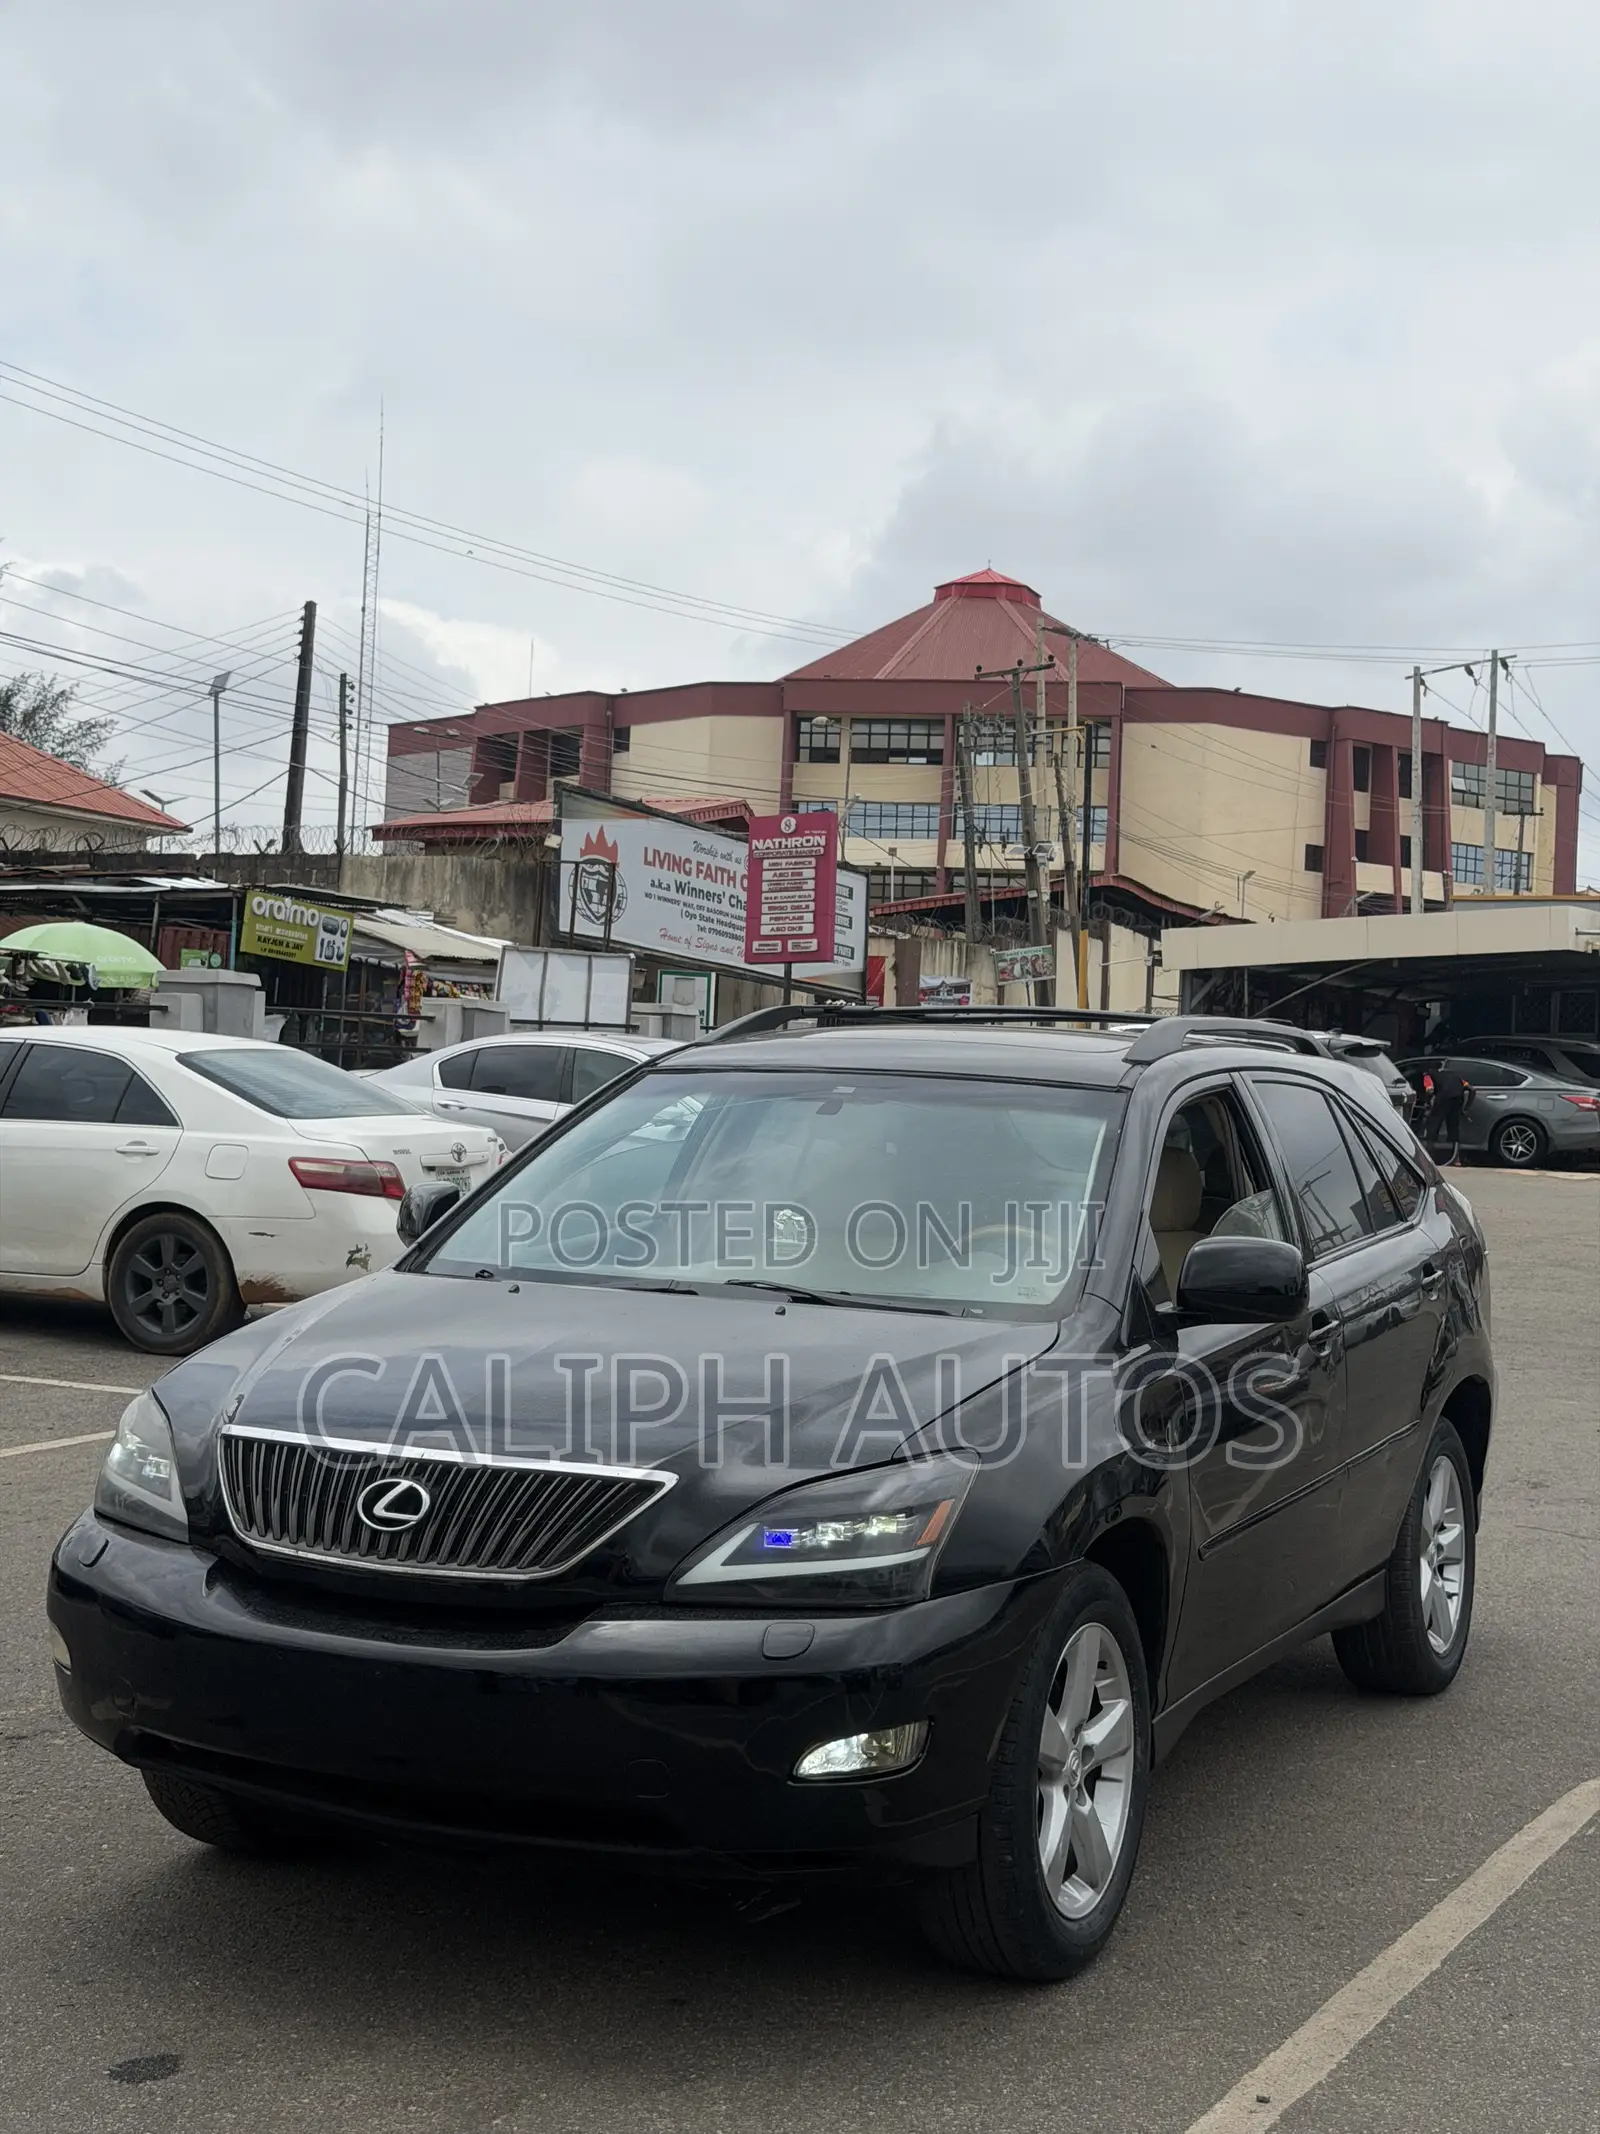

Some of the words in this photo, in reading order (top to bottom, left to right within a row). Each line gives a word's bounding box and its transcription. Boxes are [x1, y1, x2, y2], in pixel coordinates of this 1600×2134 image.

[692, 840, 718, 860] Worship
[720, 850, 734, 862] with
[752, 835, 826, 850] NATHRON
[643, 846, 692, 877] LIVING
[696, 860, 737, 889] FAITH
[674, 879, 726, 905] Winners'
[252, 896, 320, 927] oraimo
[696, 904, 705, 912] OFF
[699, 913, 715, 924] State
[659, 927, 682, 943] Home
[684, 935, 692, 949] of
[695, 937, 718, 953] Signs
[720, 945, 735, 956] and
